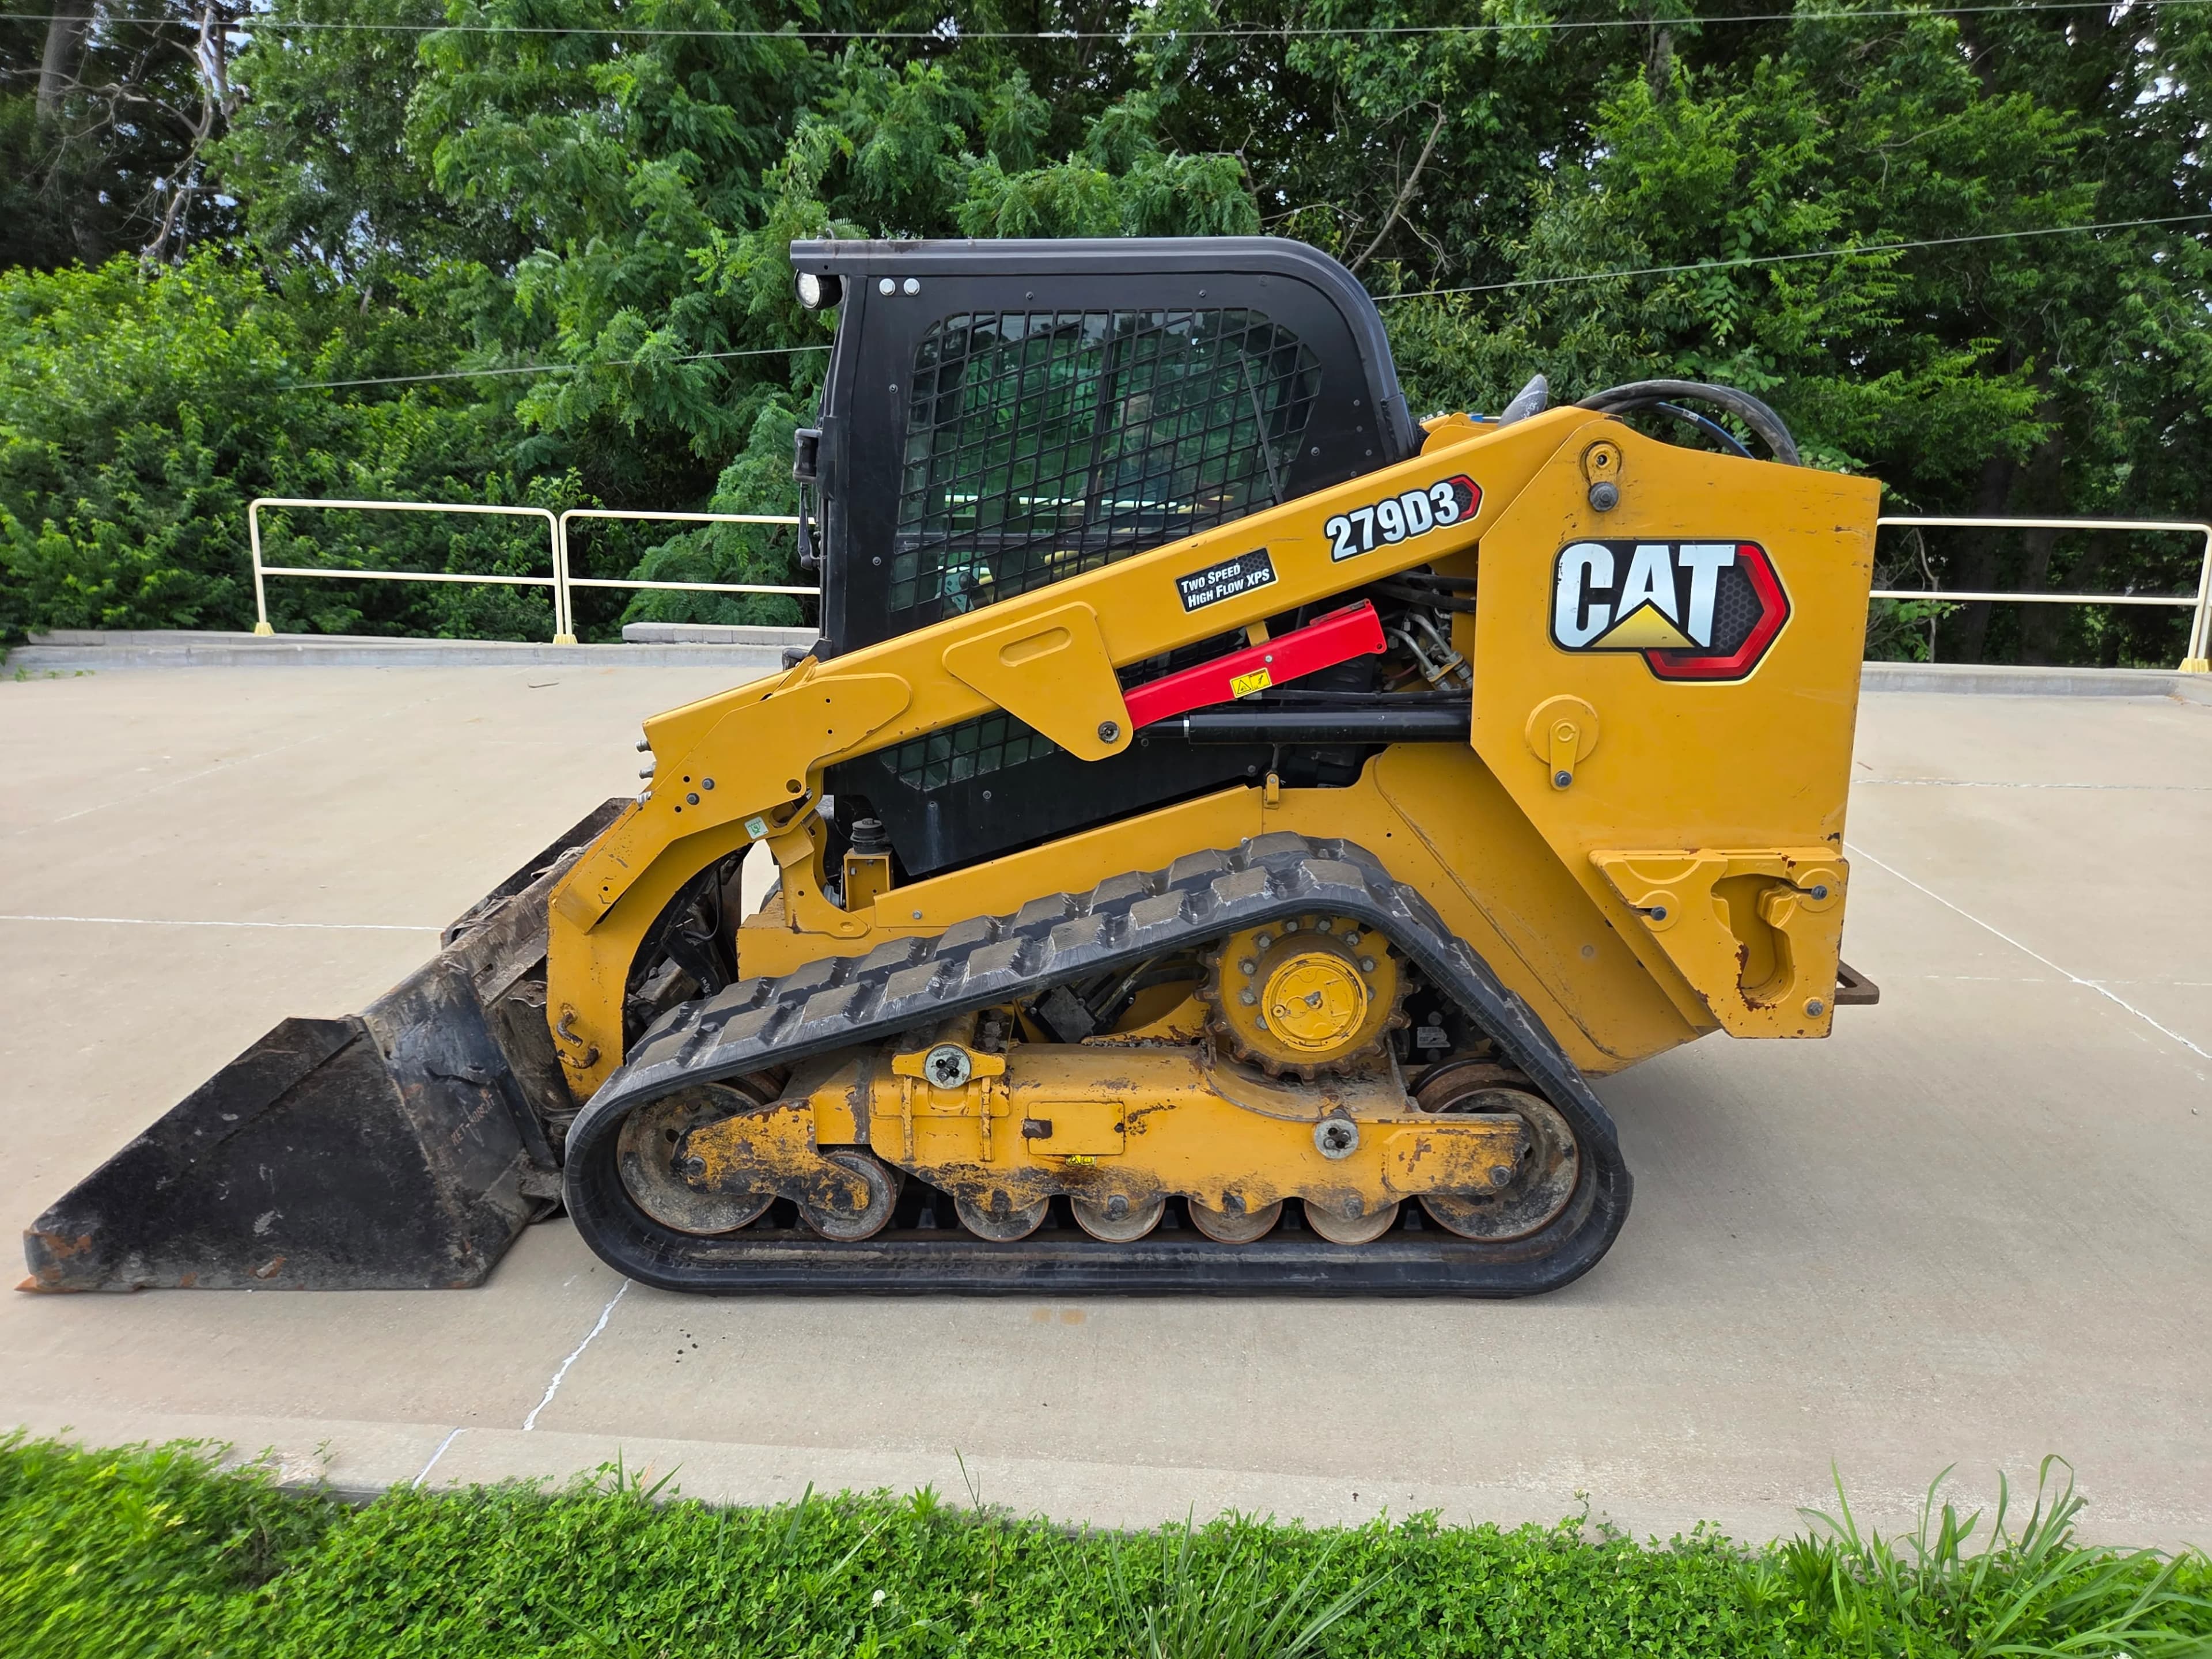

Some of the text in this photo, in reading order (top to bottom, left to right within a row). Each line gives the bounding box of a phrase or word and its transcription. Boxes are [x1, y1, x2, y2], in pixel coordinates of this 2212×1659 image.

[1326, 482, 1460, 560] 279D3
[1247, 569, 1270, 587] XPS
[1555, 543, 1736, 648] CAT
